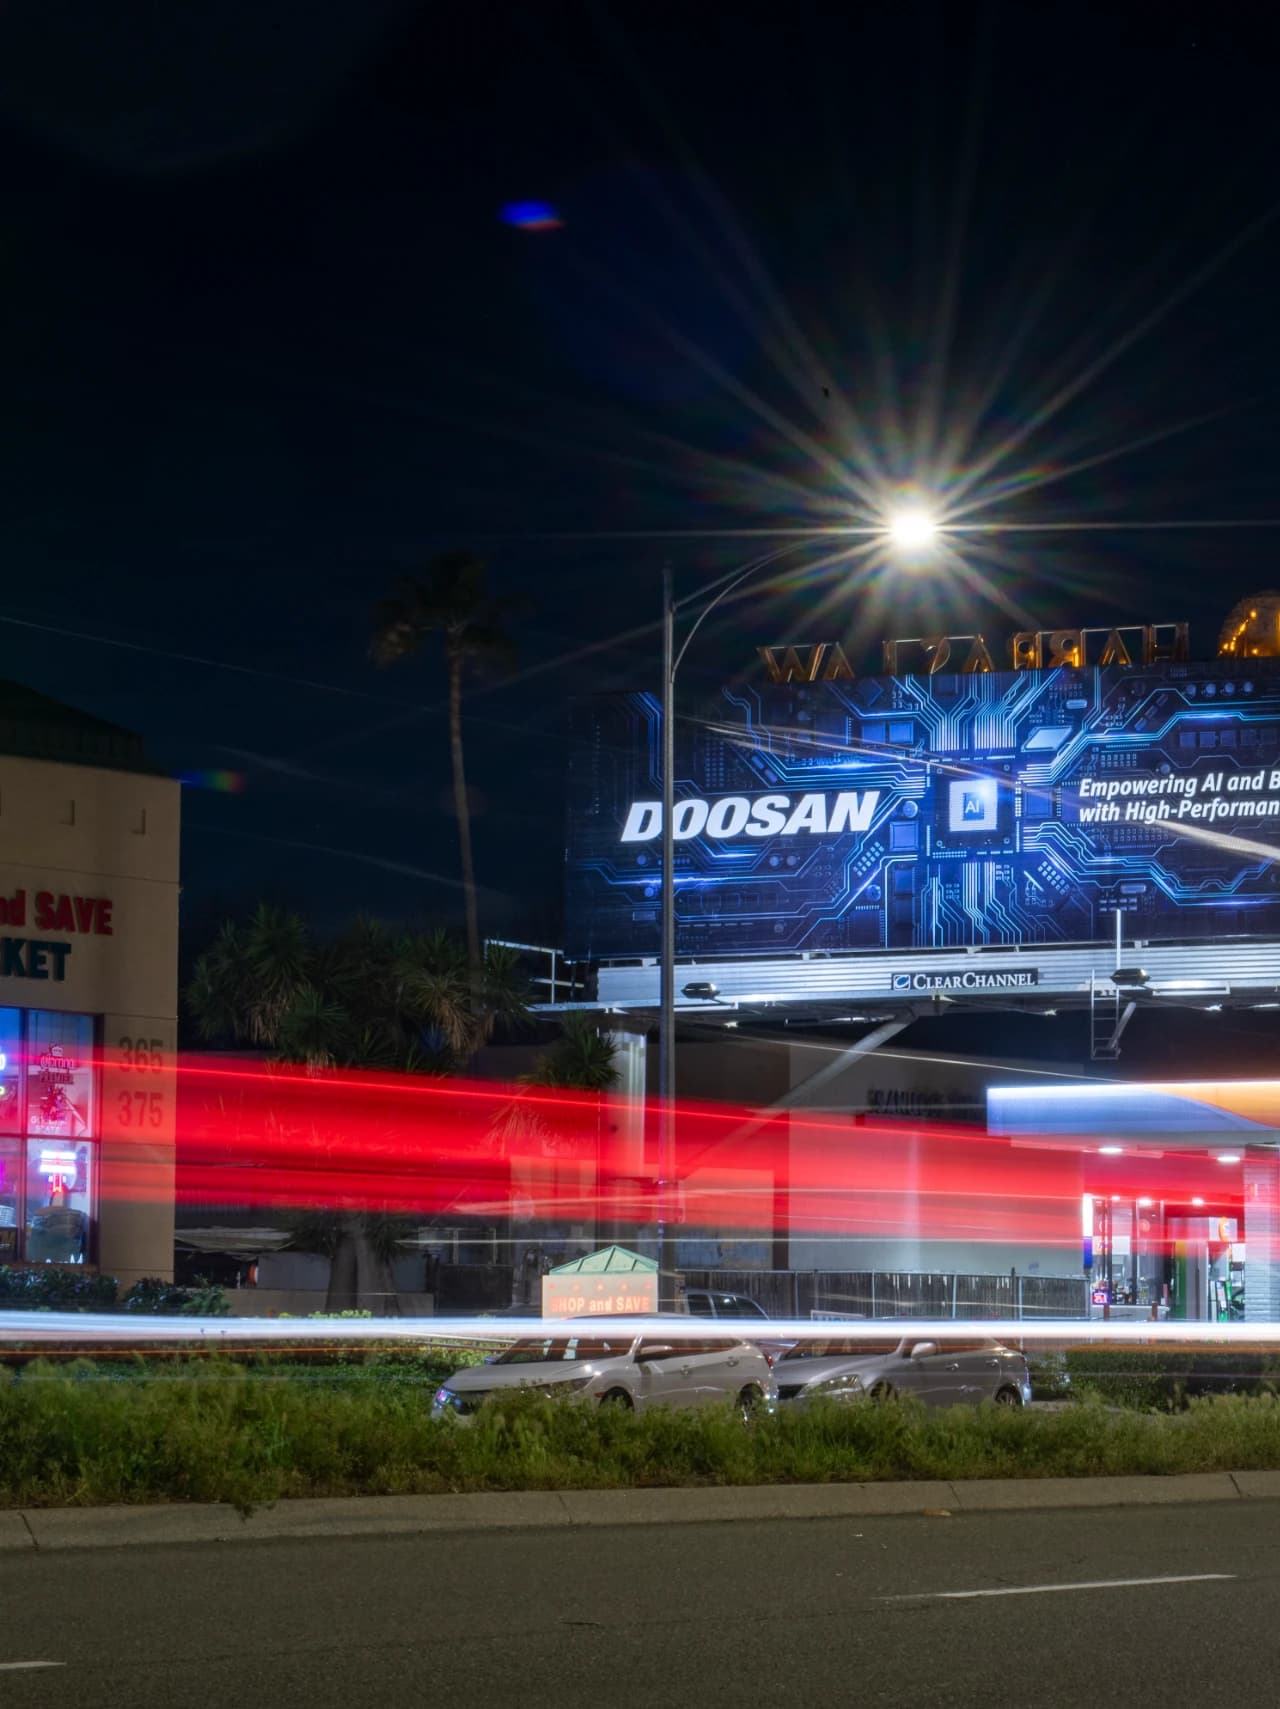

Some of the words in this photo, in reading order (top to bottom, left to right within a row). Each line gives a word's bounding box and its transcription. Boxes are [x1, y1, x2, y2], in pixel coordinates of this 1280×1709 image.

[1079, 774, 1198, 800] Empowering
[1202, 773, 1223, 792] AI
[1227, 771, 1264, 791] and
[621, 791, 881, 842] DOOSAN
[965, 800, 980, 814] AI
[1079, 804, 1120, 823] with
[35, 891, 114, 936] SAVE
[119, 1036, 163, 1075] 365
[119, 1090, 163, 1128] 375
[589, 1296, 613, 1312] and
[616, 1296, 650, 1312] SAVE
